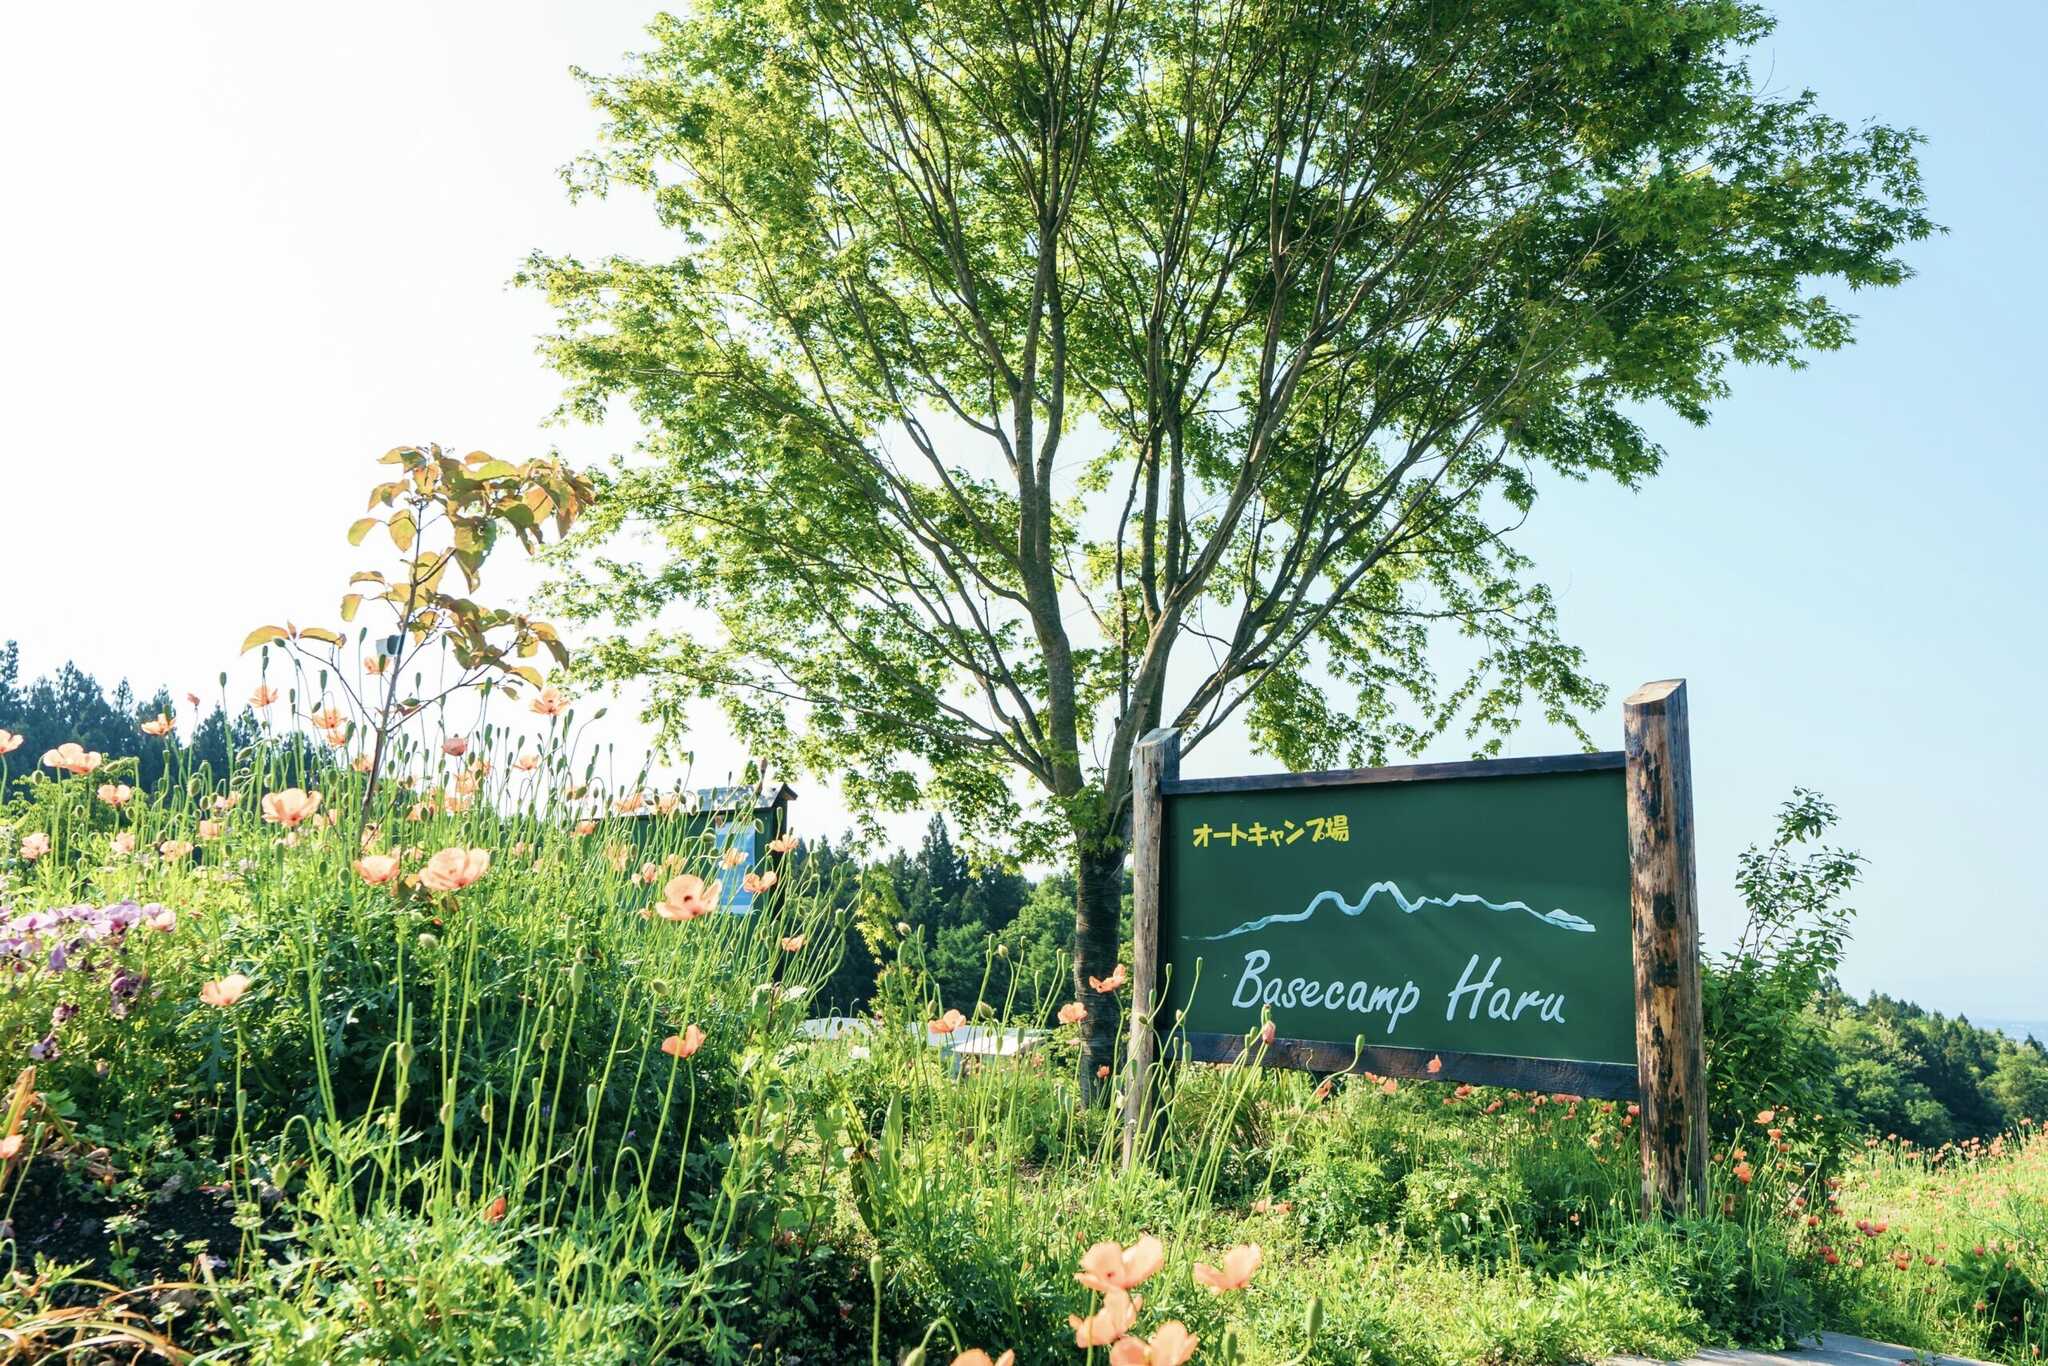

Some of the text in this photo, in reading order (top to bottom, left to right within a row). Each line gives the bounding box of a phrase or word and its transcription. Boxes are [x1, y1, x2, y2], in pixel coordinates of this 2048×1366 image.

[1192, 814, 1350, 848] オートキャンプ場
[1232, 949, 1566, 1034] Basecamp Haru
